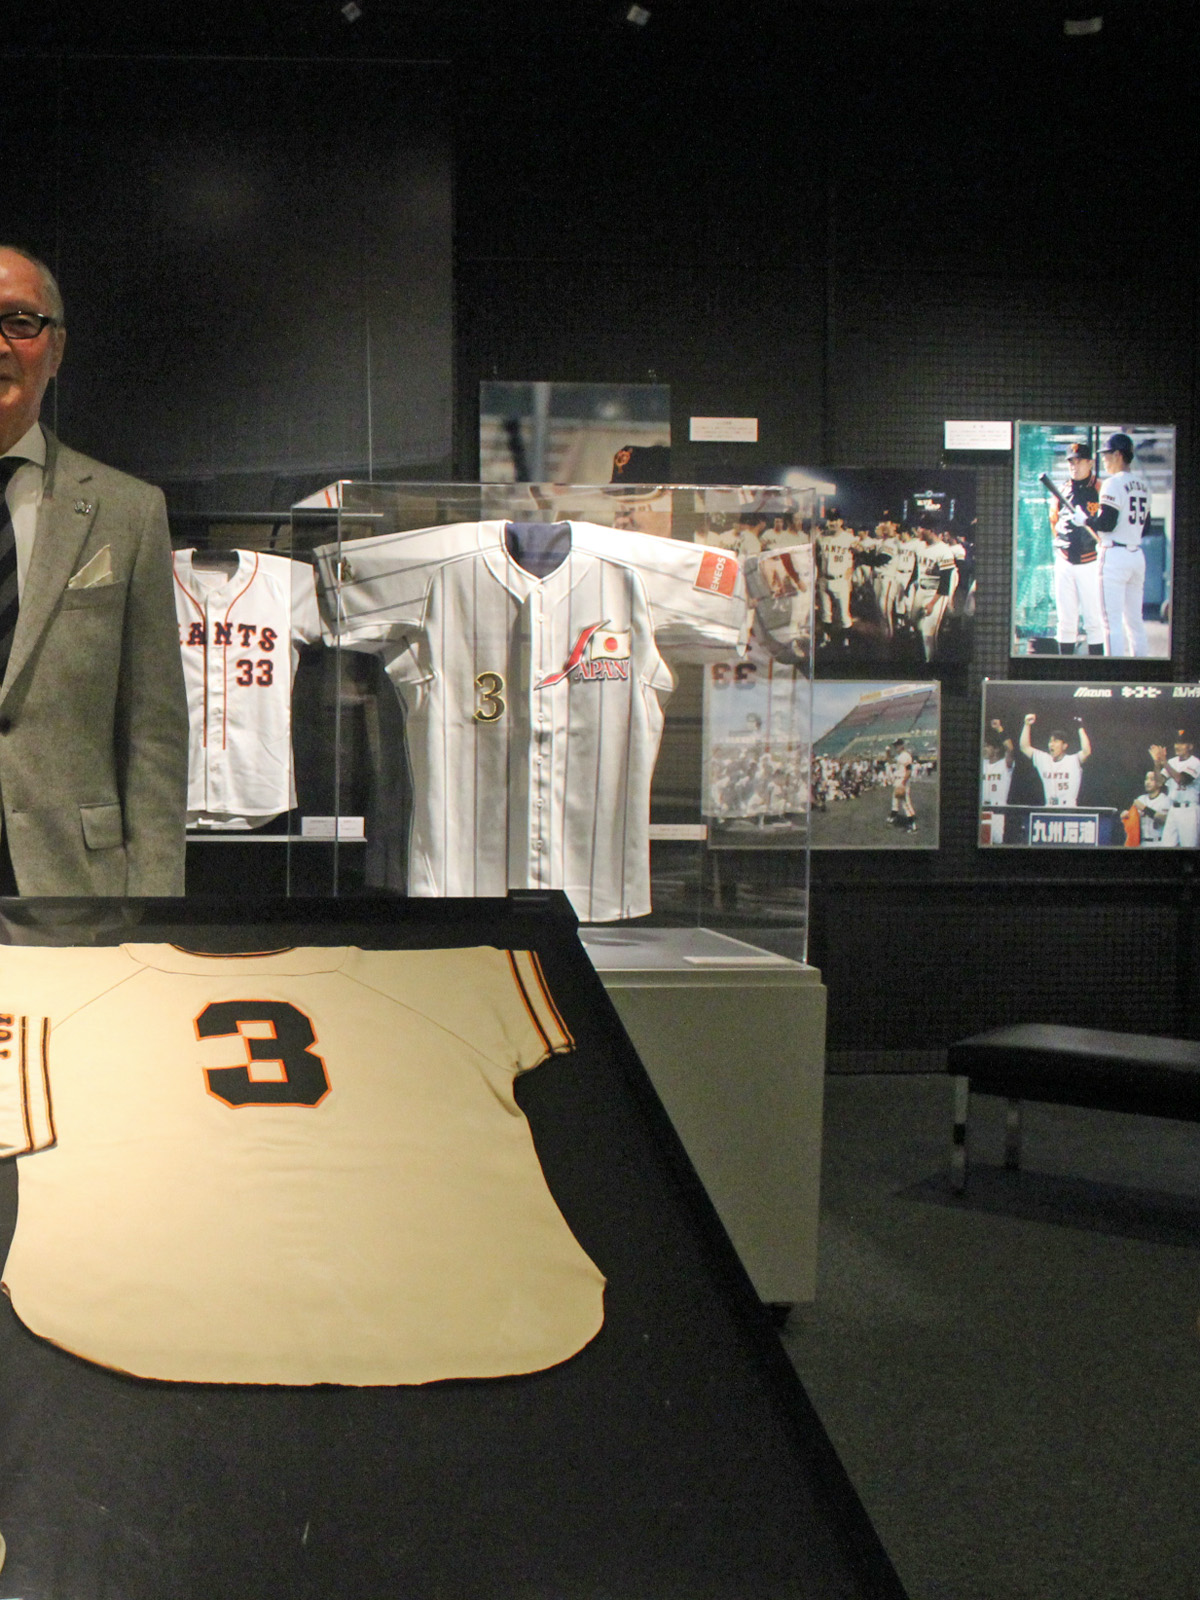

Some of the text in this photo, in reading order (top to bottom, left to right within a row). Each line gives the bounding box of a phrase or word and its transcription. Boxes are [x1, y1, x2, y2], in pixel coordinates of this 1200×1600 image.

[1128, 496, 1148, 526] 55
[710, 556, 726, 590] ENEOS
[178, 621, 278, 652] ANTS
[236, 659, 274, 687] 33
[473, 671, 506, 722] 3
[192, 998, 333, 1110] 3
